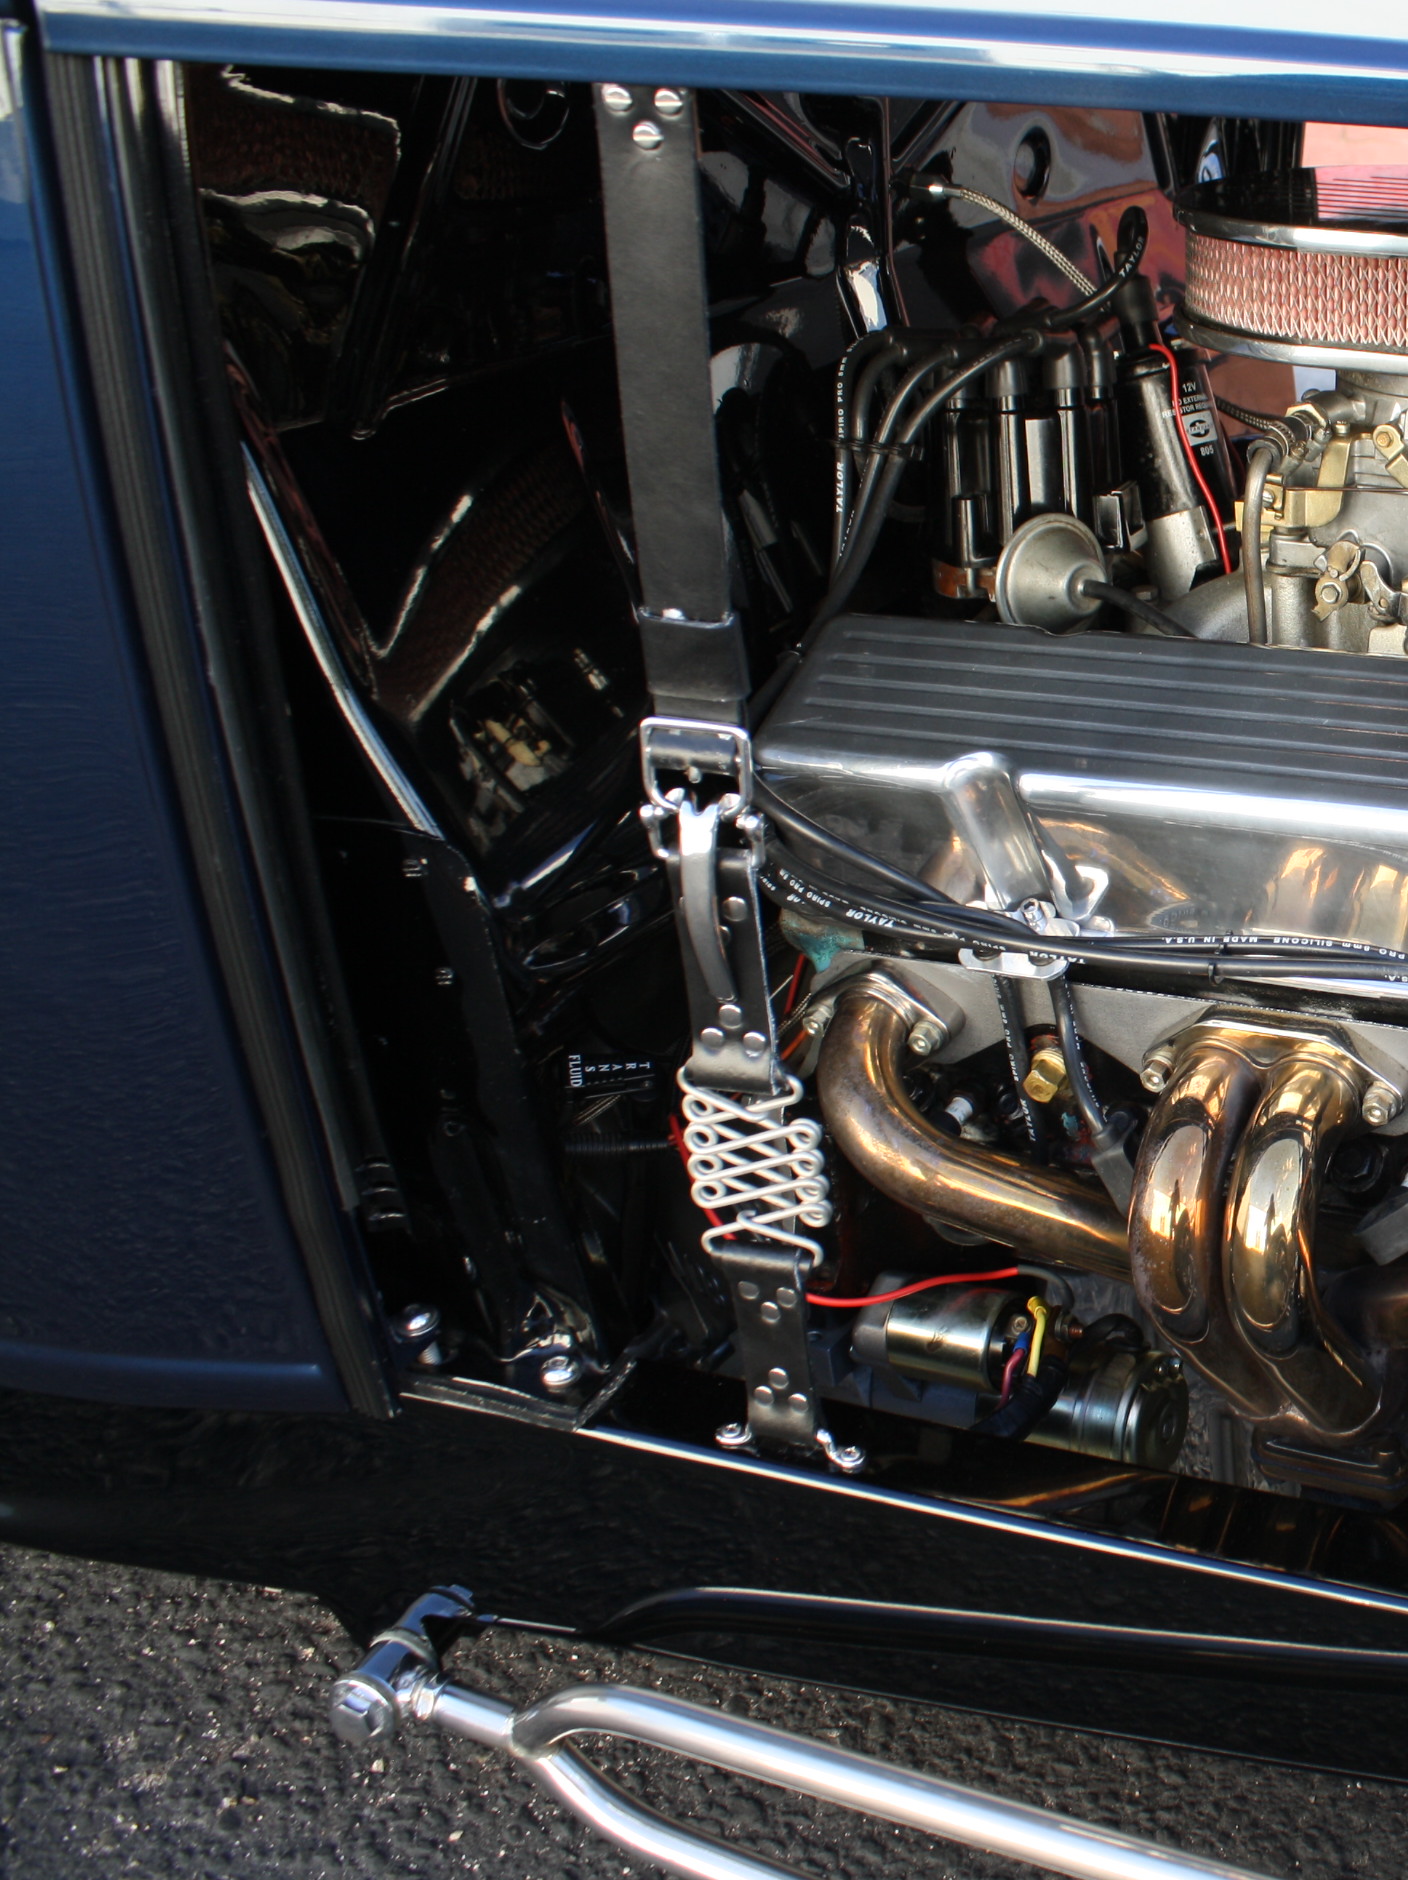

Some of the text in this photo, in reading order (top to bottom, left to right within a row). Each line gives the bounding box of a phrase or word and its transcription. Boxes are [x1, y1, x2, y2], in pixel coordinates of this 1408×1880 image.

[1119, 236, 1144, 278] TAYLOR
[1182, 381, 1197, 393] 12V
[1200, 444, 1215, 457] 805
[835, 461, 845, 513] TAYLOR
[789, 879, 805, 893] PRO
[806, 891, 831, 908] SPIRO
[845, 908, 897, 929] TAYLOR
[1161, 936, 1196, 944] U.S.A.
[1222, 935, 1258, 943] MADE
[1273, 936, 1333, 947] SILICONE
[1341, 941, 1371, 952] 8mm
[1378, 947, 1406, 960] PRO
[568, 1054, 583, 1087] FLUID
